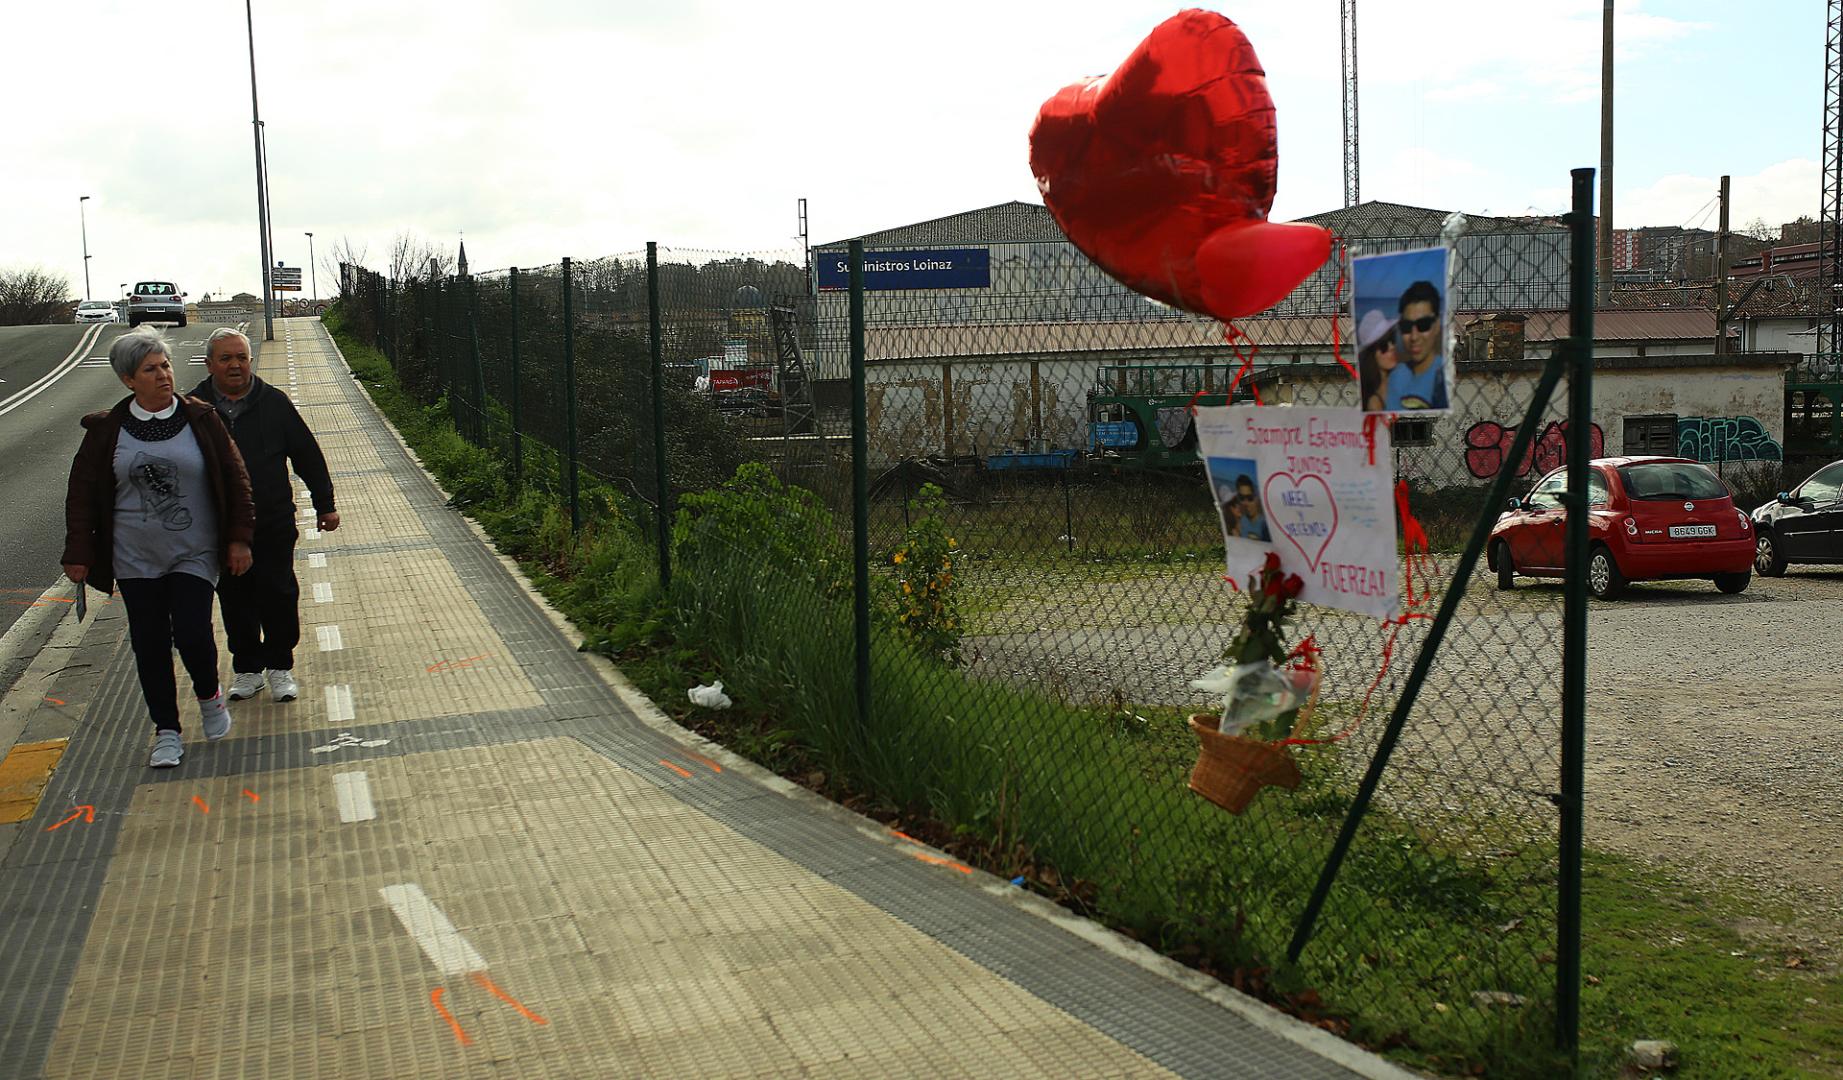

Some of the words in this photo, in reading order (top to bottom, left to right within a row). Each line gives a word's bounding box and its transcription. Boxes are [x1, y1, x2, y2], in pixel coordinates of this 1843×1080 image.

[837, 260, 910, 273] Suinistros
[913, 259, 952, 271] Loinaz
[1247, 417, 1303, 455] Siempre
[1287, 456, 1332, 475] JUNTOS
[1674, 527, 1696, 536] 8649
[1321, 561, 1386, 597] FUERZA!
